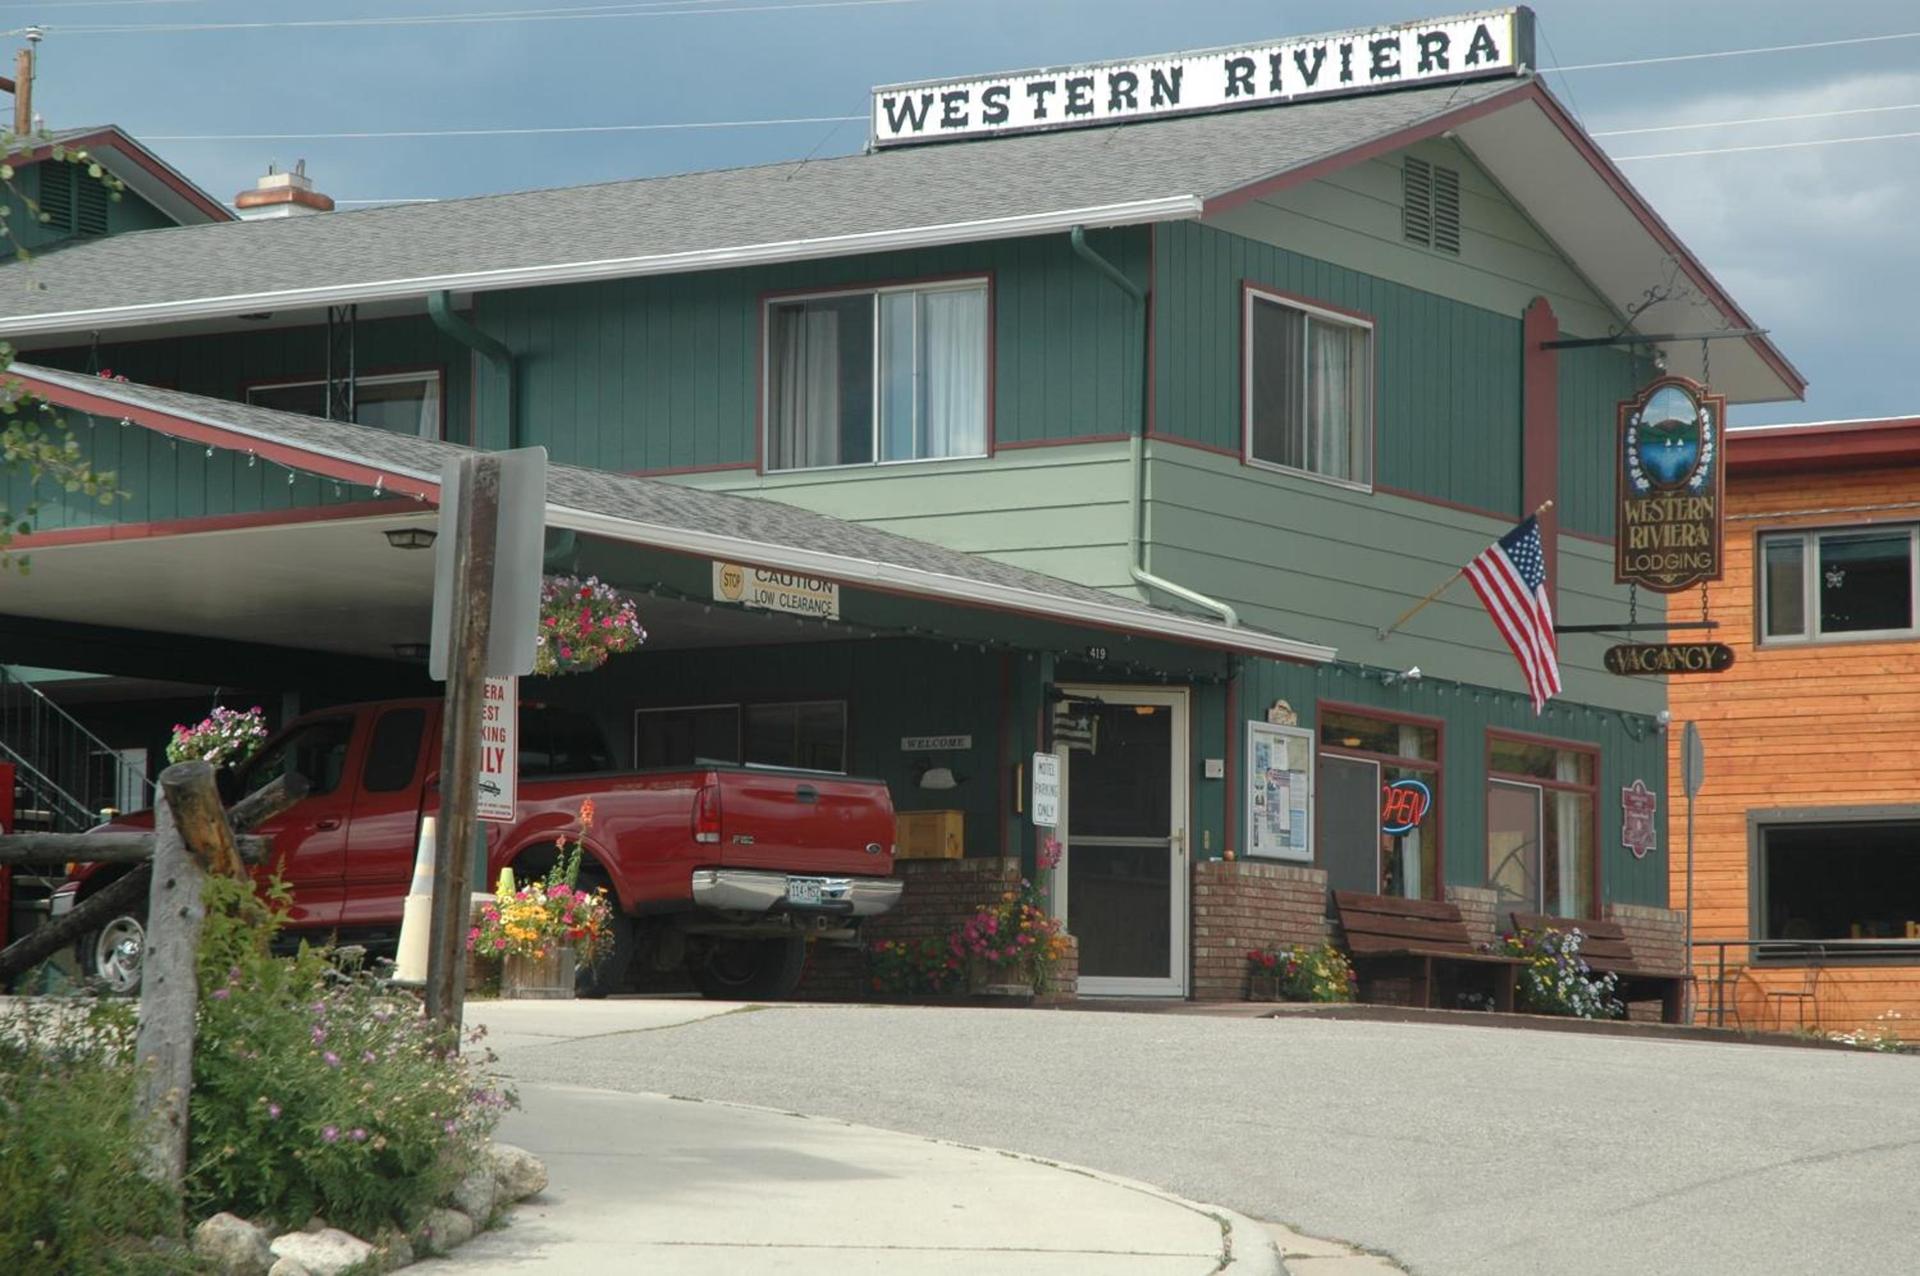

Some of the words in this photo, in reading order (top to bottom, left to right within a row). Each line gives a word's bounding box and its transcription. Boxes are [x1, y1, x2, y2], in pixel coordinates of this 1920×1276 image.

[882, 66, 1184, 134] WESTERN
[1223, 23, 1501, 98] RIVIERA
[1624, 497, 1714, 524] WESTERN
[1628, 523, 1710, 550] RIVIERA
[1625, 551, 1712, 572] LODGING
[723, 572, 741, 588] STOP
[754, 568, 833, 594] CAUTION
[754, 589, 776, 605] LOW
[779, 592, 833, 616] CLEARANCE
[1089, 647, 1106, 660] 419
[1615, 646, 1718, 673] VACANCY
[482, 705, 500, 721] EST
[480, 726, 507, 743] KING
[906, 736, 966, 749] WELCOME
[480, 746, 505, 774] LY
[1037, 802, 1055, 818] ONLY
